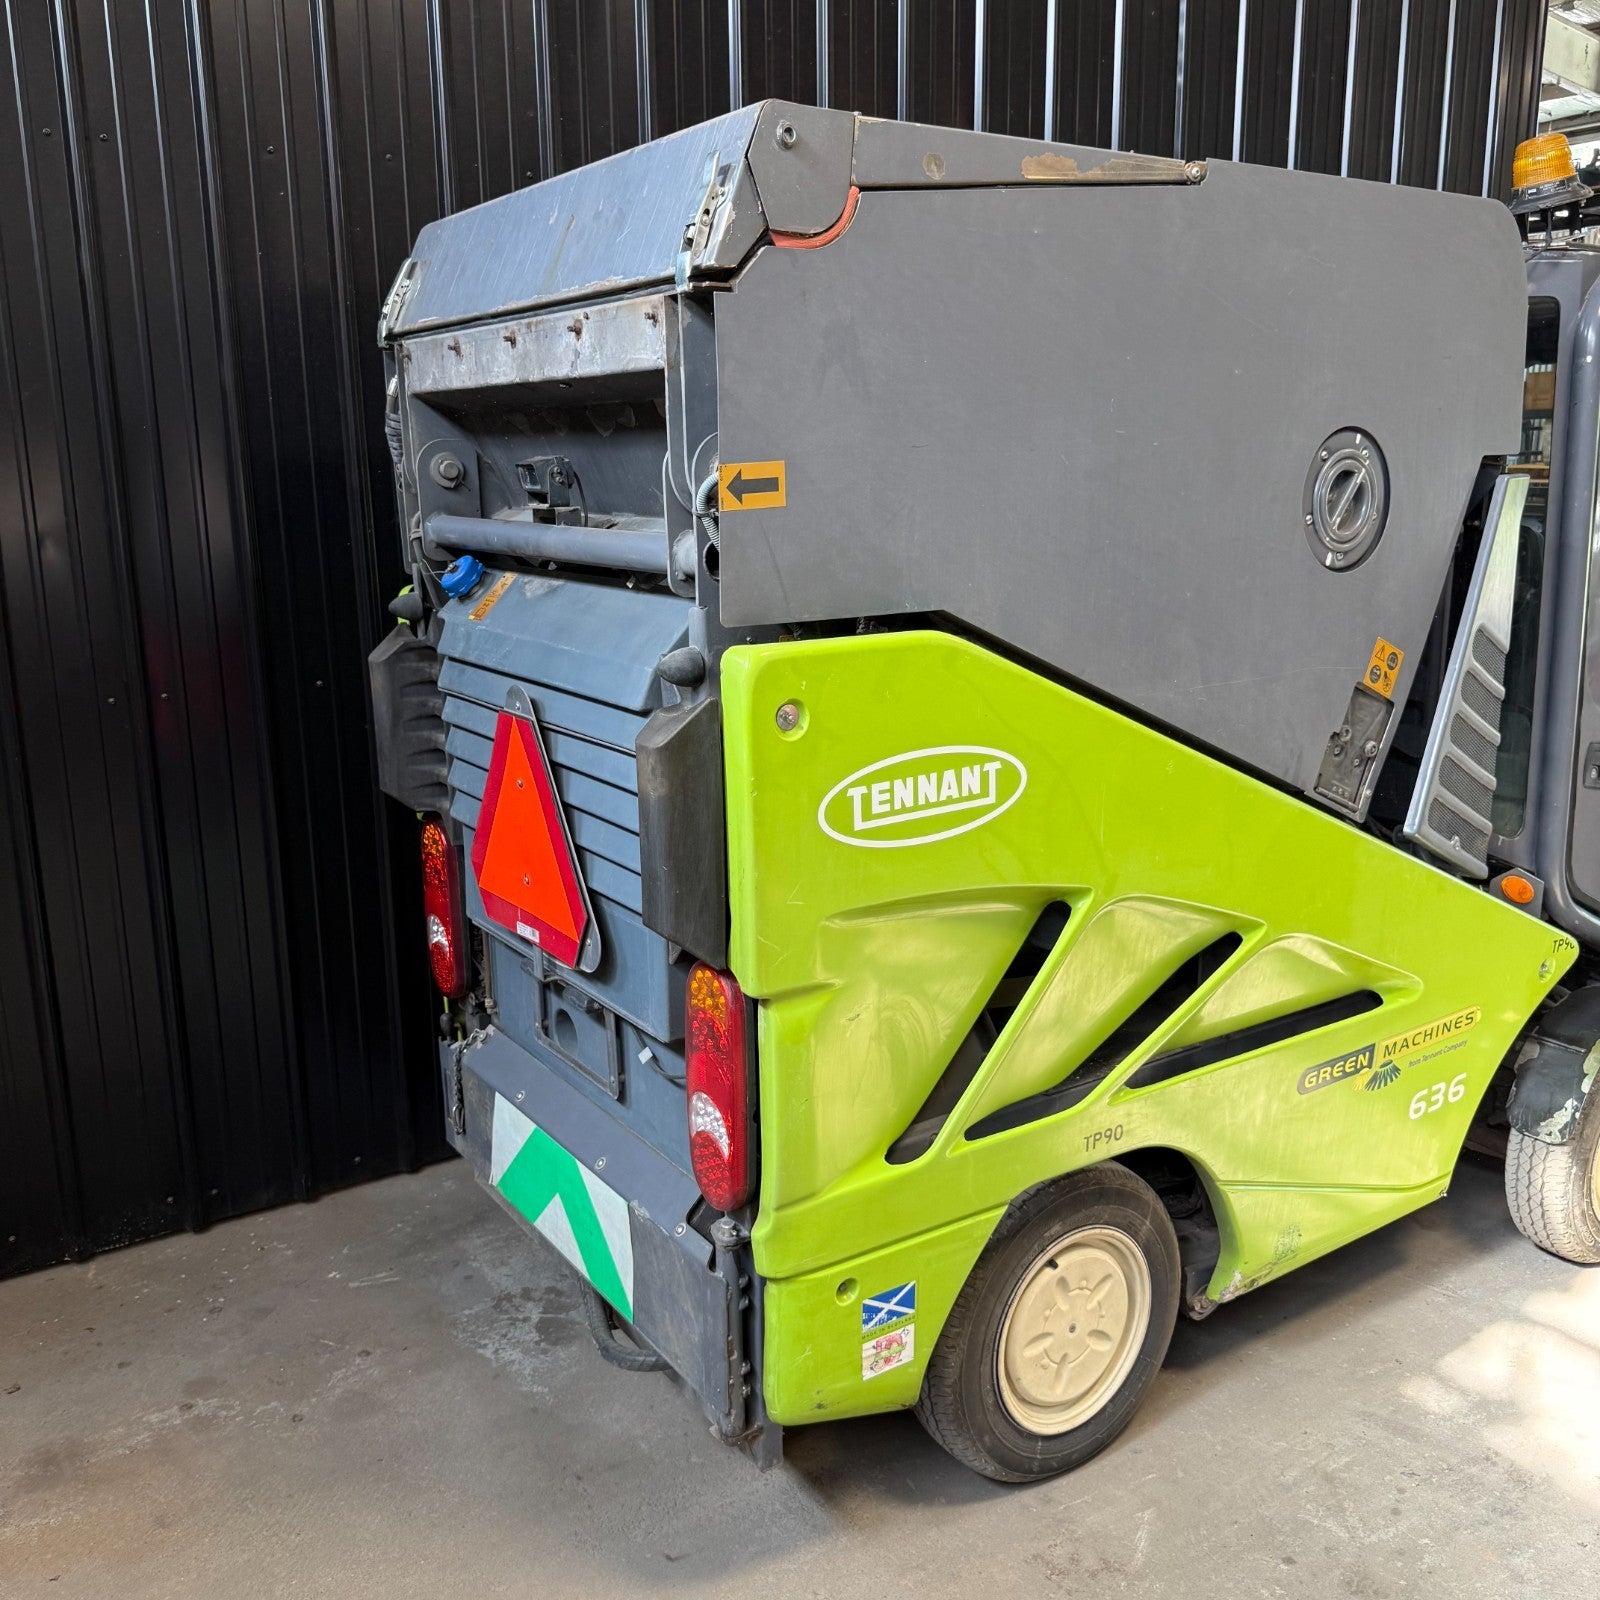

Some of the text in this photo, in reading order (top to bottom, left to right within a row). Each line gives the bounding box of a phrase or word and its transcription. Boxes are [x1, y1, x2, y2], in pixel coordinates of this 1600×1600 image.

[846, 760, 1002, 831] TENNANT
[1304, 1010, 1475, 1088] GREEN MACHINES
[1422, 1049, 1443, 1062] Tennant
[1443, 1040, 1468, 1054] Company
[1408, 1072, 1467, 1120] 636
[1083, 1124, 1124, 1152] TP90
